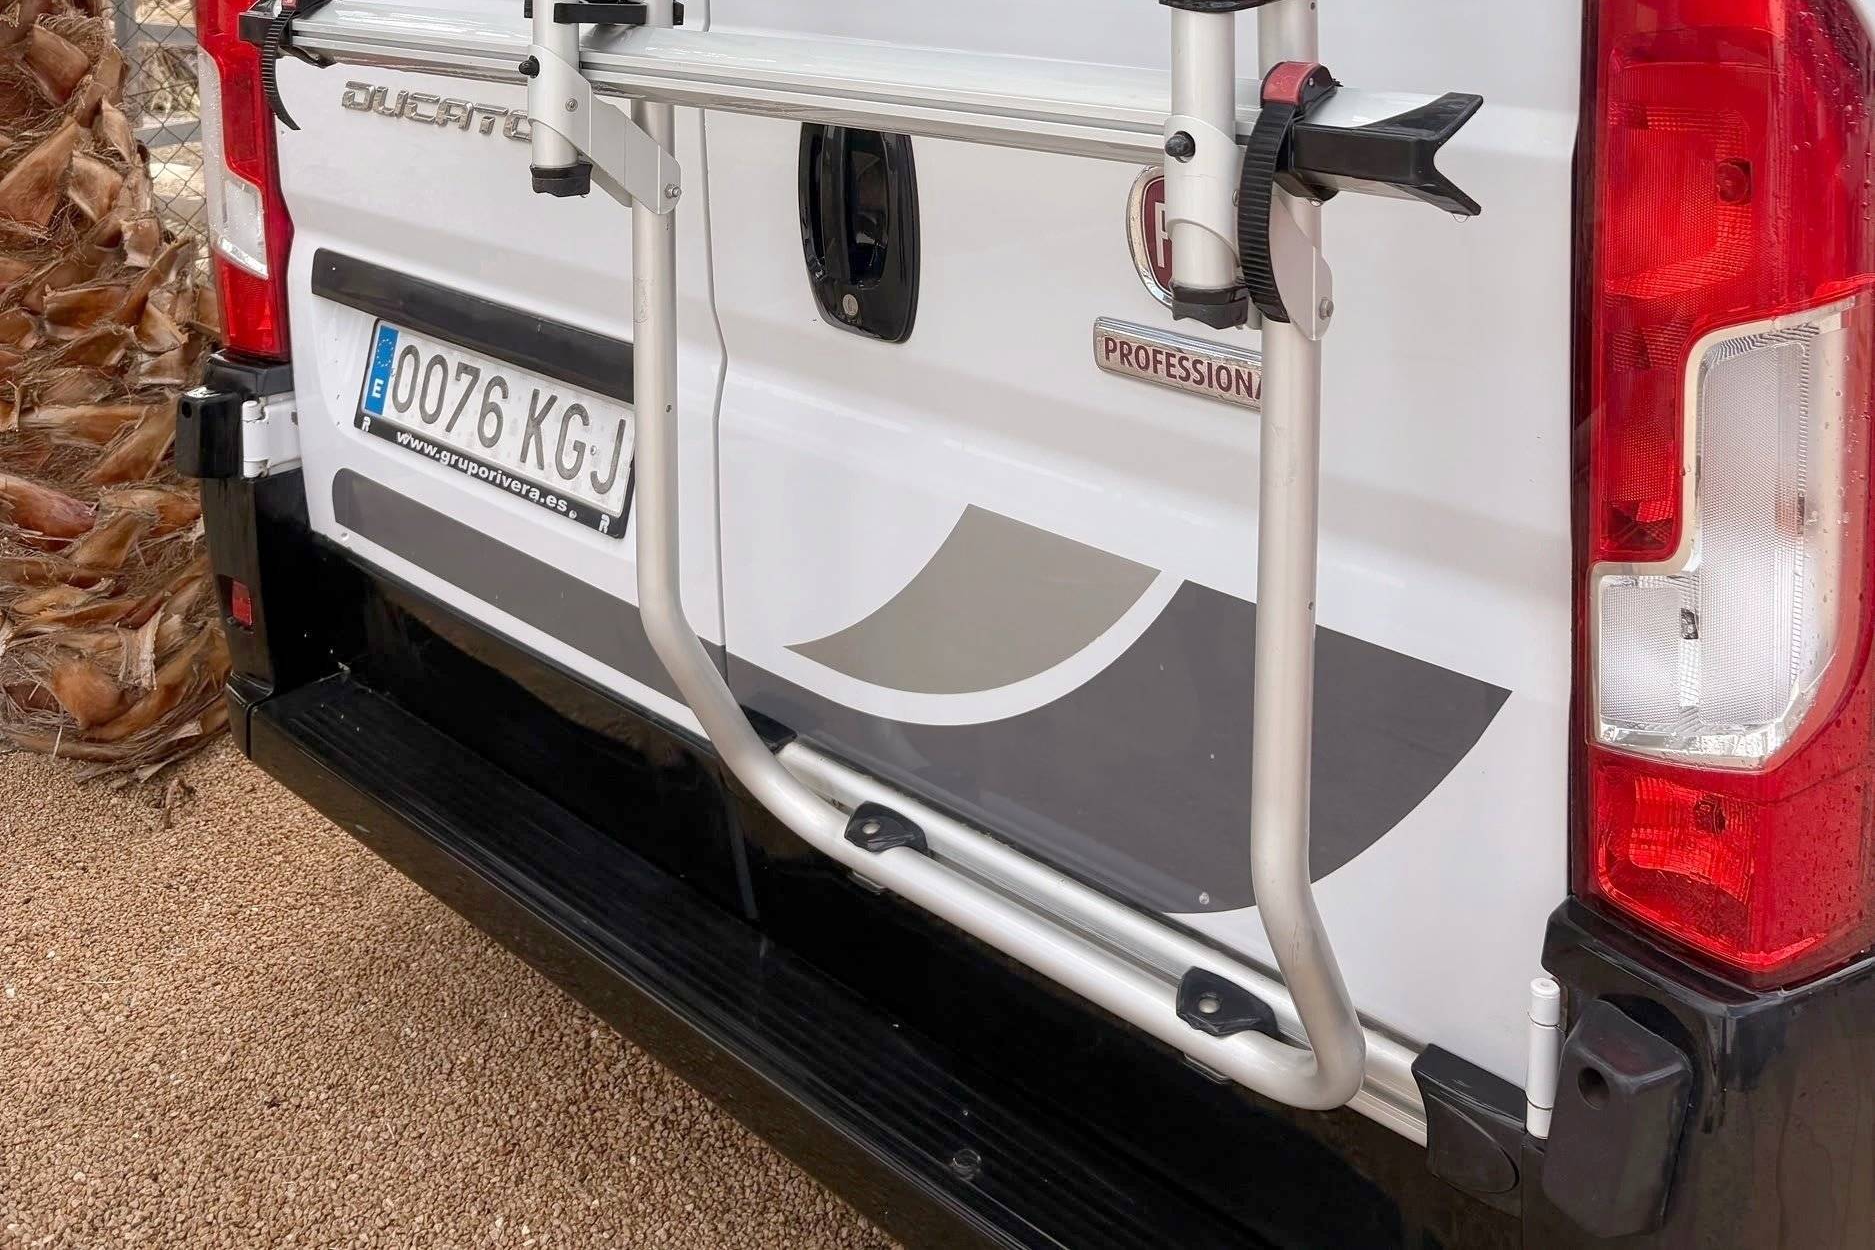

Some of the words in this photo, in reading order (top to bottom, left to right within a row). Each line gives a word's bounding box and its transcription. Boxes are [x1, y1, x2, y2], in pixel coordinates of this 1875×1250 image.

[341, 80, 532, 142] DUCATO
[371, 378, 384, 398] E
[1104, 336, 1261, 399] PROFESSION
[391, 344, 509, 449] 0076
[520, 388, 627, 495] KGJ
[396, 431, 568, 512] www.gruporivera.es
